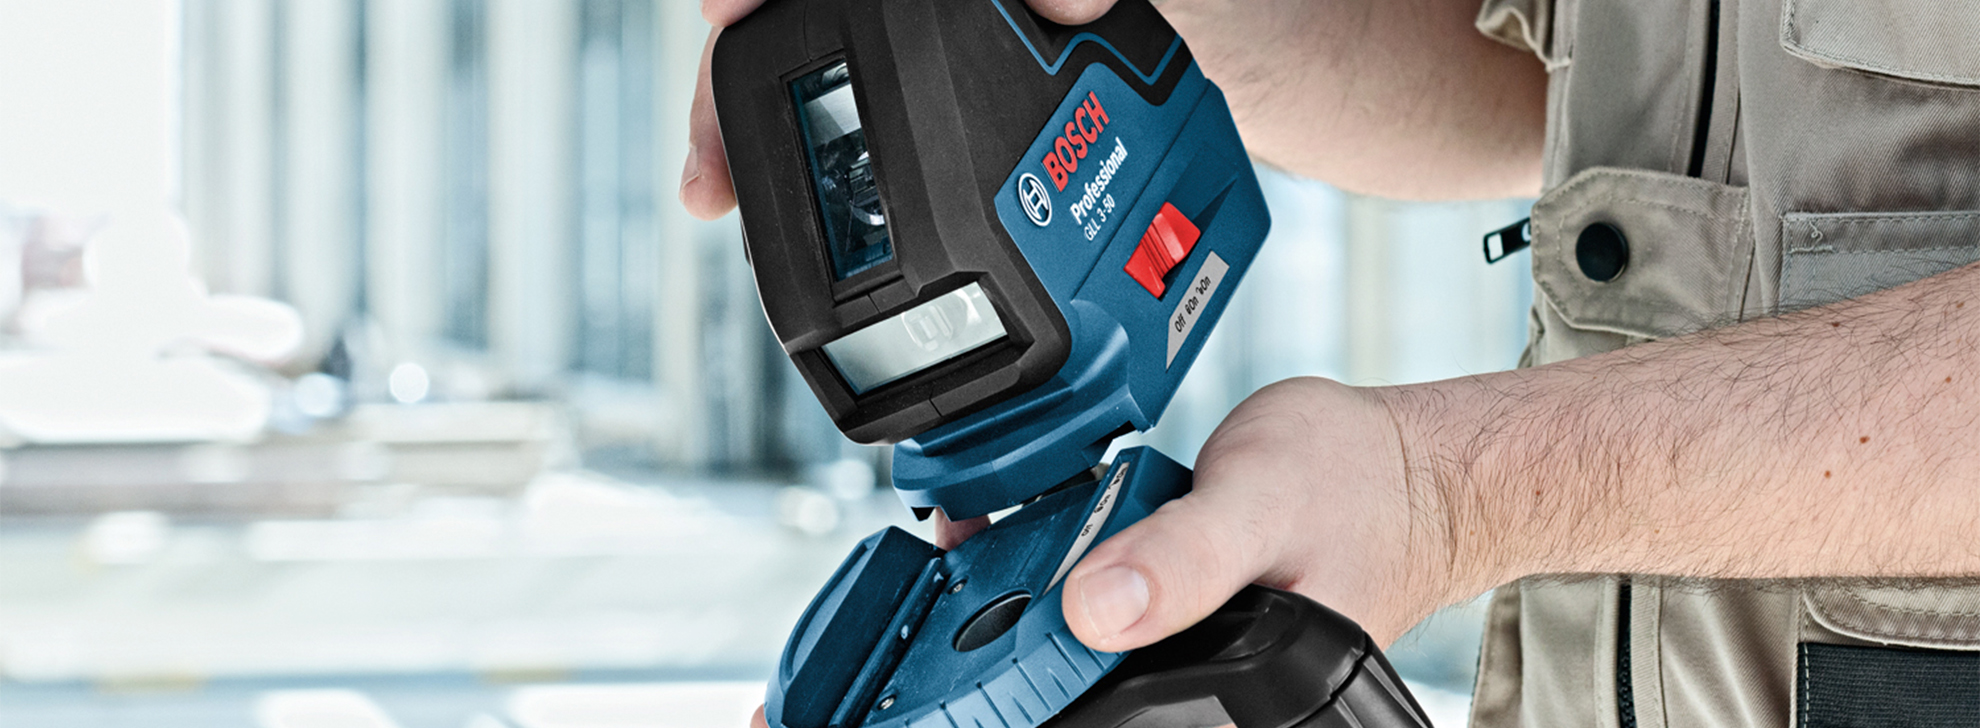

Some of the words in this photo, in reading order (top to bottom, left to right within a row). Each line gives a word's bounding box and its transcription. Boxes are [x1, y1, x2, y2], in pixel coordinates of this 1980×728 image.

[1042, 91, 1110, 192] BOSCH
[1070, 136, 1128, 225] Professional
[1084, 218, 1101, 241] GLL
[1097, 193, 1115, 222] 3-50
[1174, 312, 1187, 333] Off
